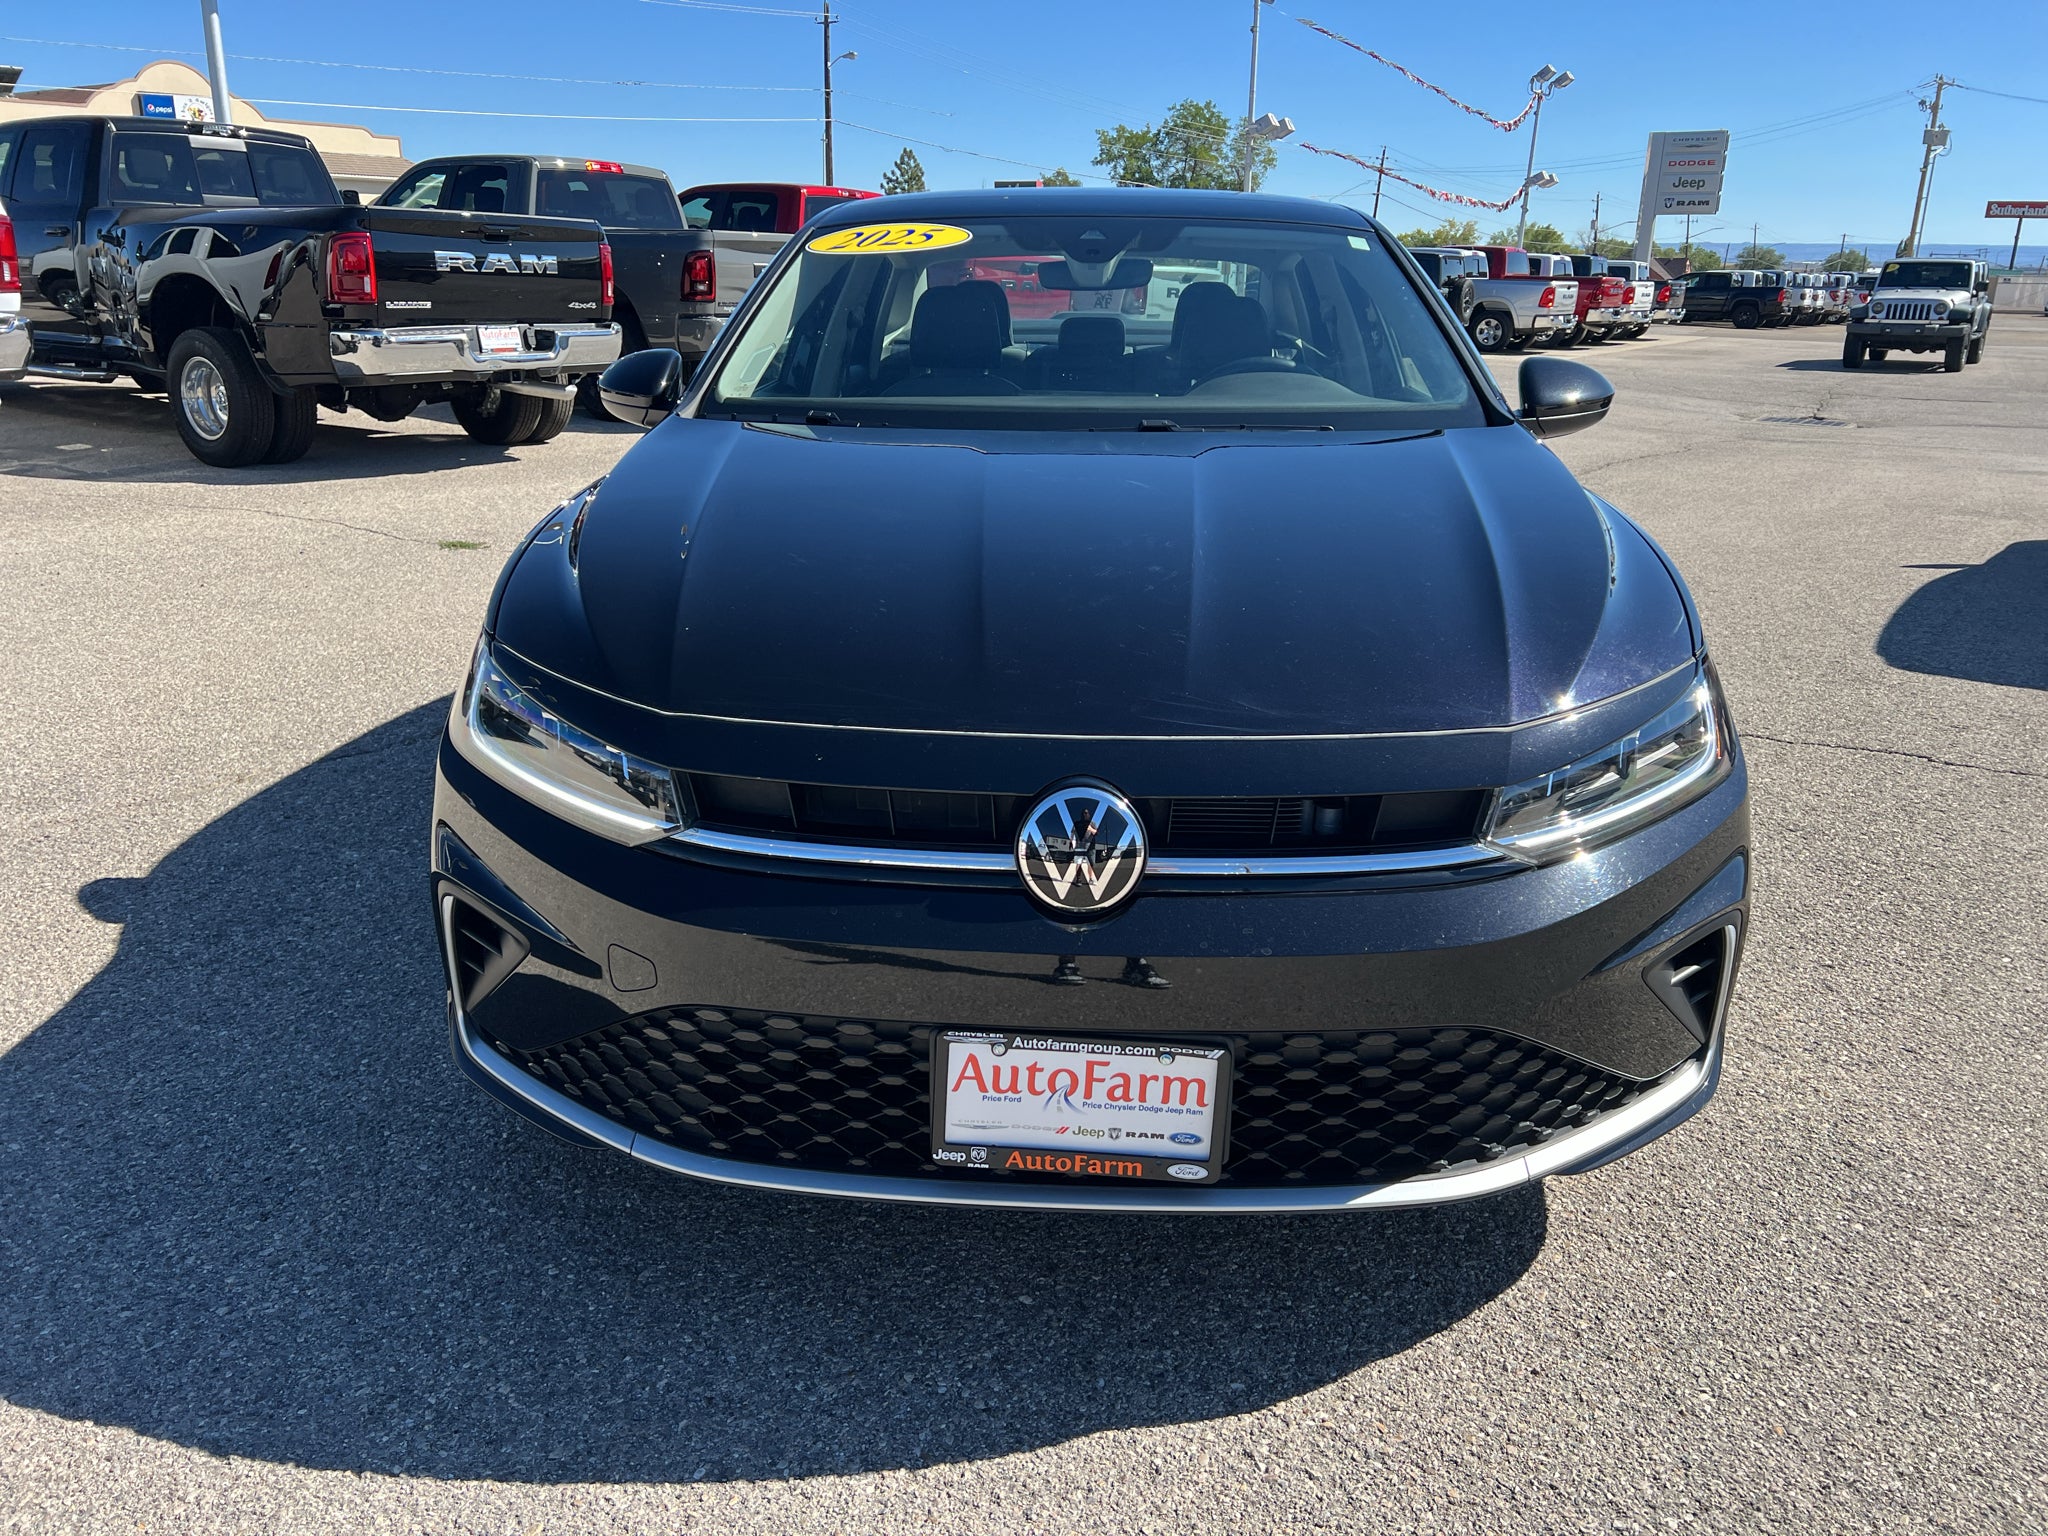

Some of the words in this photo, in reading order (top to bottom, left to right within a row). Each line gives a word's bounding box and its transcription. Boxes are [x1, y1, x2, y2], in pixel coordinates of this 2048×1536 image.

[1672, 176, 1705, 190] Jeep
[825, 228, 946, 251] 2025
[434, 250, 559, 275] RAM
[568, 301, 598, 309] 4x4
[481, 330, 519, 339] AutoFarm
[1012, 1036, 1156, 1056] Autofarmgroup.com
[951, 1052, 1210, 1108] AutoFarm
[982, 1094, 1001, 1102] Price
[1003, 1095, 1022, 1103] Ford
[1082, 1101, 1101, 1109] Price
[1103, 1102, 1136, 1112] Chrysler
[1138, 1105, 1163, 1113] Dodge
[1165, 1106, 1184, 1115] Jeep
[1185, 1107, 1203, 1116] Ram
[1072, 1125, 1105, 1139] Jeep
[1125, 1131, 1165, 1140] RAM
[1174, 1133, 1196, 1144] Ford
[932, 1148, 967, 1162] Jeep
[1005, 1150, 1143, 1177] AutoFarm
[1174, 1166, 1200, 1177] Ford
